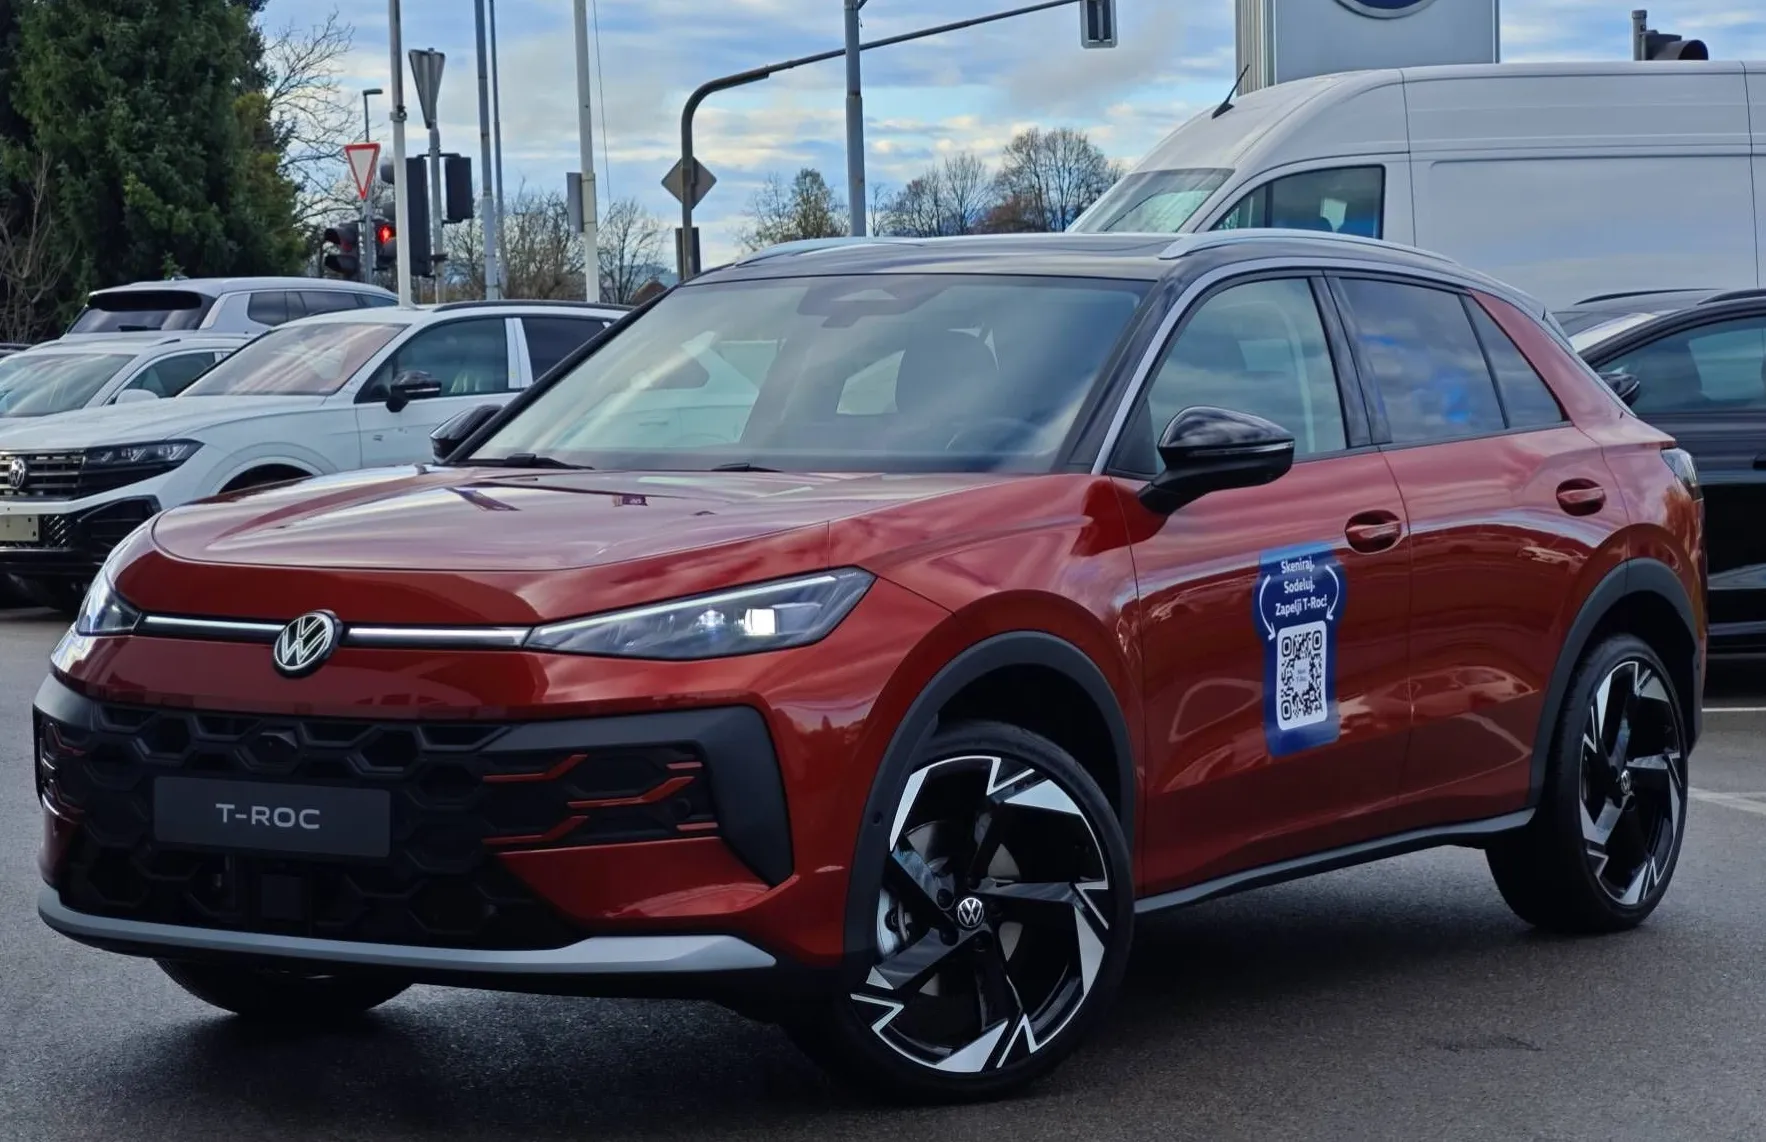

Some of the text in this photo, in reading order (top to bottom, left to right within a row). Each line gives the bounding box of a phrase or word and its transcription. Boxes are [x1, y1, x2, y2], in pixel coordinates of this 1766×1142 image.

[1284, 576, 1315, 593] Sodeluj.
[1275, 594, 1327, 617] Zapelji T-Roc!
[215, 803, 321, 830] T-ROC
